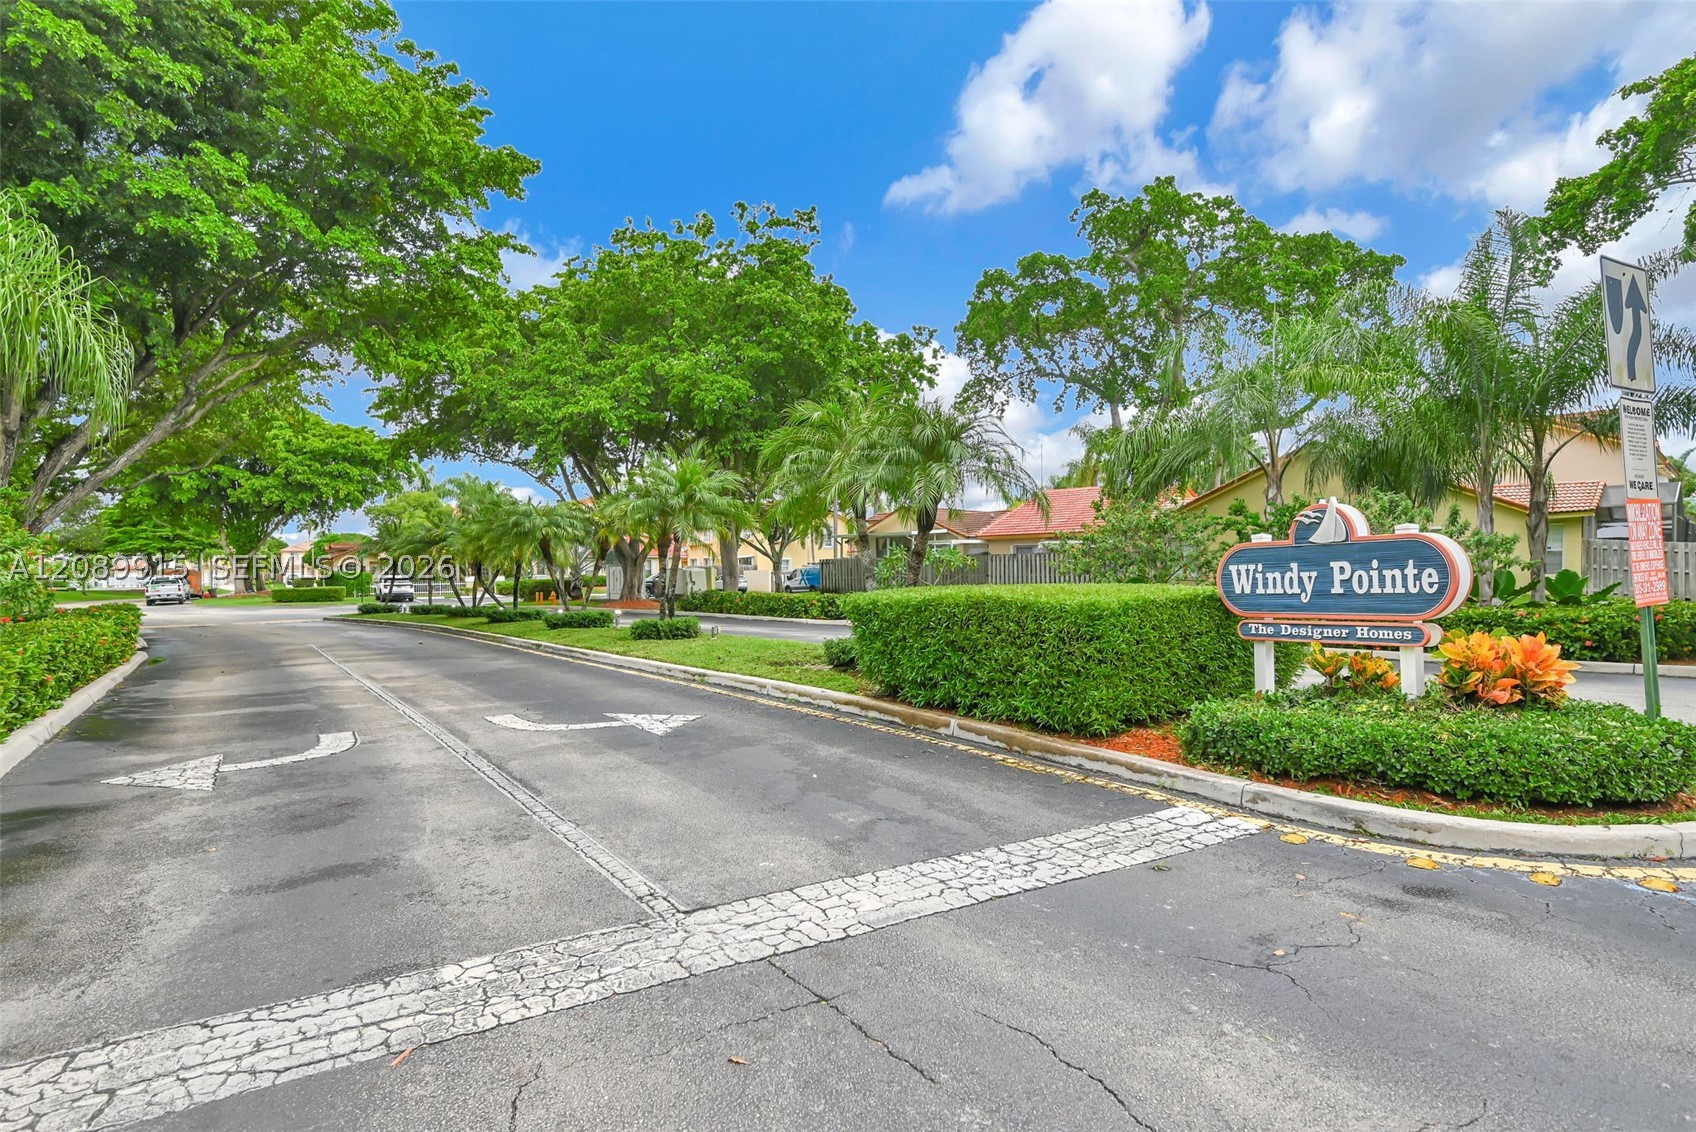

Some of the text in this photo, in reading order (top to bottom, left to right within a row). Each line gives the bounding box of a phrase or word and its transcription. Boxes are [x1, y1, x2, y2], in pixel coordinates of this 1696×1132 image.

[1228, 559, 1439, 603] Windy Pointe
[1248, 623, 1412, 640] The Designer Homes
